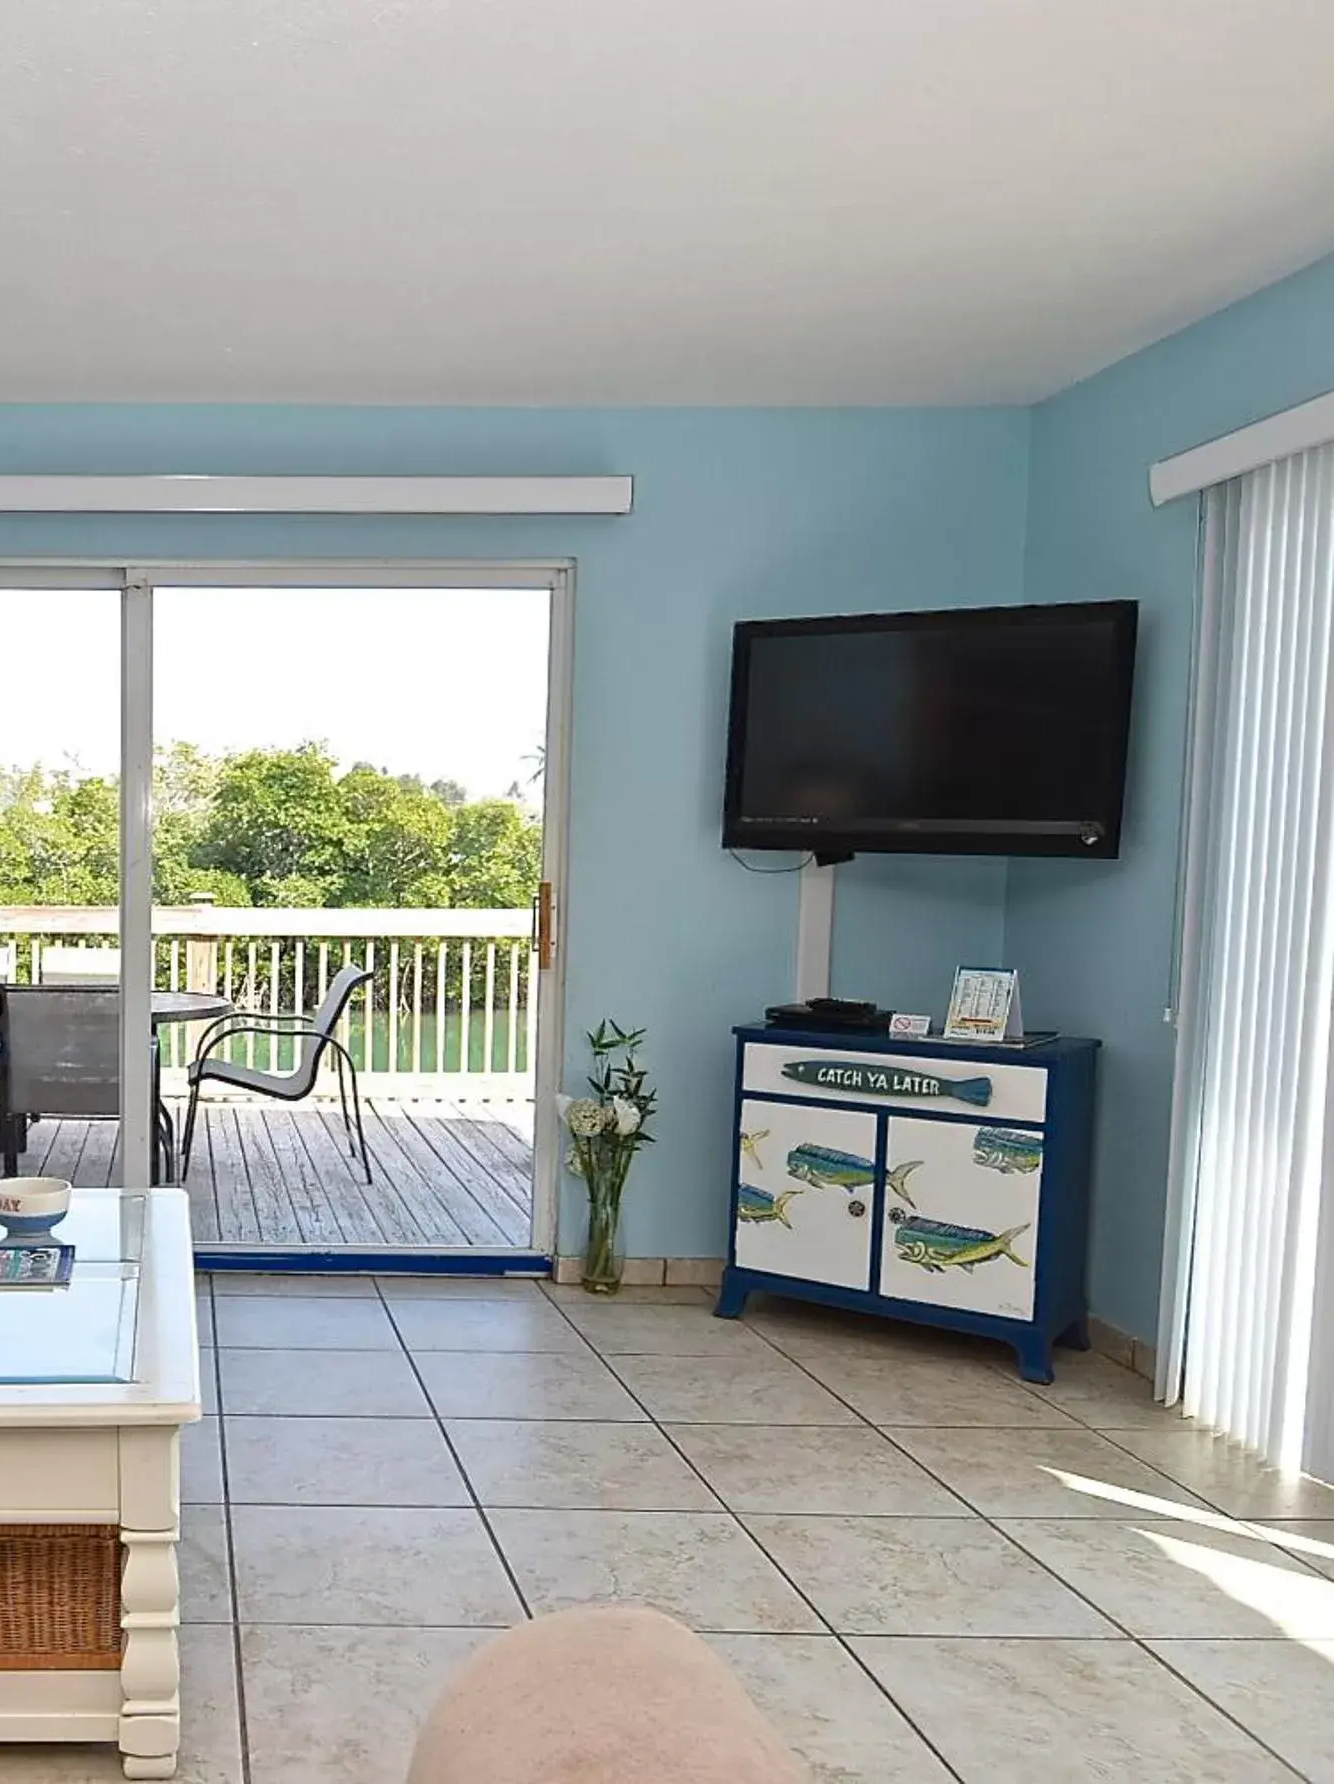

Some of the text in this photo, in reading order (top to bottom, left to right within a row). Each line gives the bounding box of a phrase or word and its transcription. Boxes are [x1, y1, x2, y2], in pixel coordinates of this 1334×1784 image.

[817, 1067, 940, 1096] CATCH YA LATER
